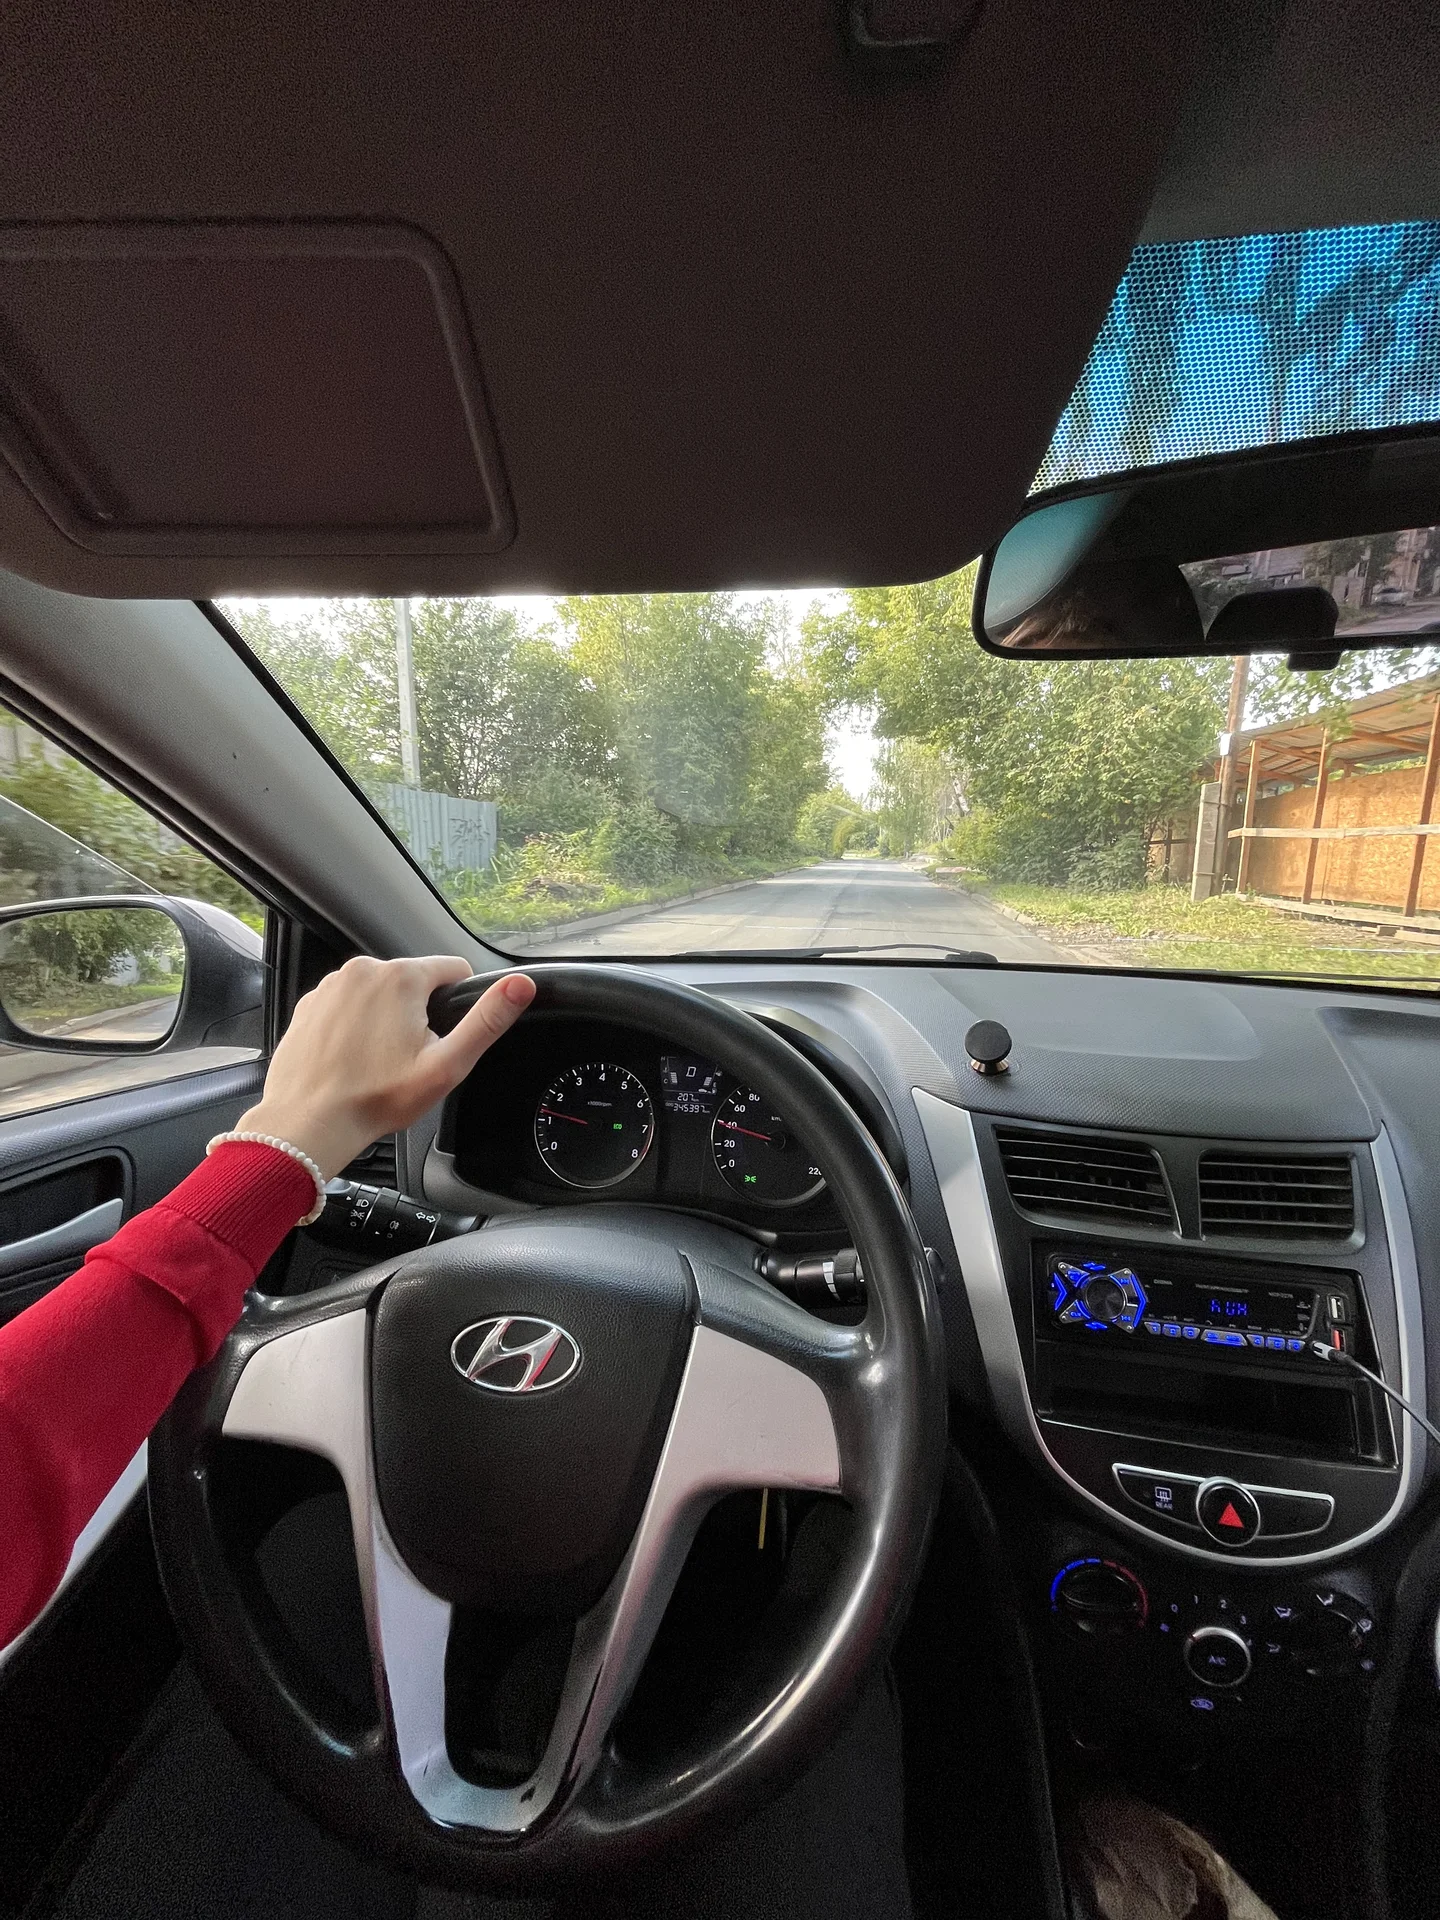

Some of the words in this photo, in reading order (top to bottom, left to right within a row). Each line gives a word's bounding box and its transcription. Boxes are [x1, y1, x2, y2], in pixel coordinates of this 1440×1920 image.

[599, 1072, 606, 1081] 4
[575, 1077, 582, 1086] 3
[621, 1081, 628, 1090] 5
[557, 1093, 564, 1102] 2
[637, 1100, 644, 1108] 6
[734, 1104, 746, 1113] 60
[548, 1116, 552, 1125] 1
[641, 1125, 648, 1134] 7
[725, 1121, 738, 1130] 40
[550, 1141, 558, 1150] 0
[723, 1140, 735, 1148] 20
[631, 1149, 638, 1158] 8
[728, 1159, 735, 1168] 0
[1155, 1501, 1173, 1510] REAR
[1220, 1599, 1227, 1609] 2
